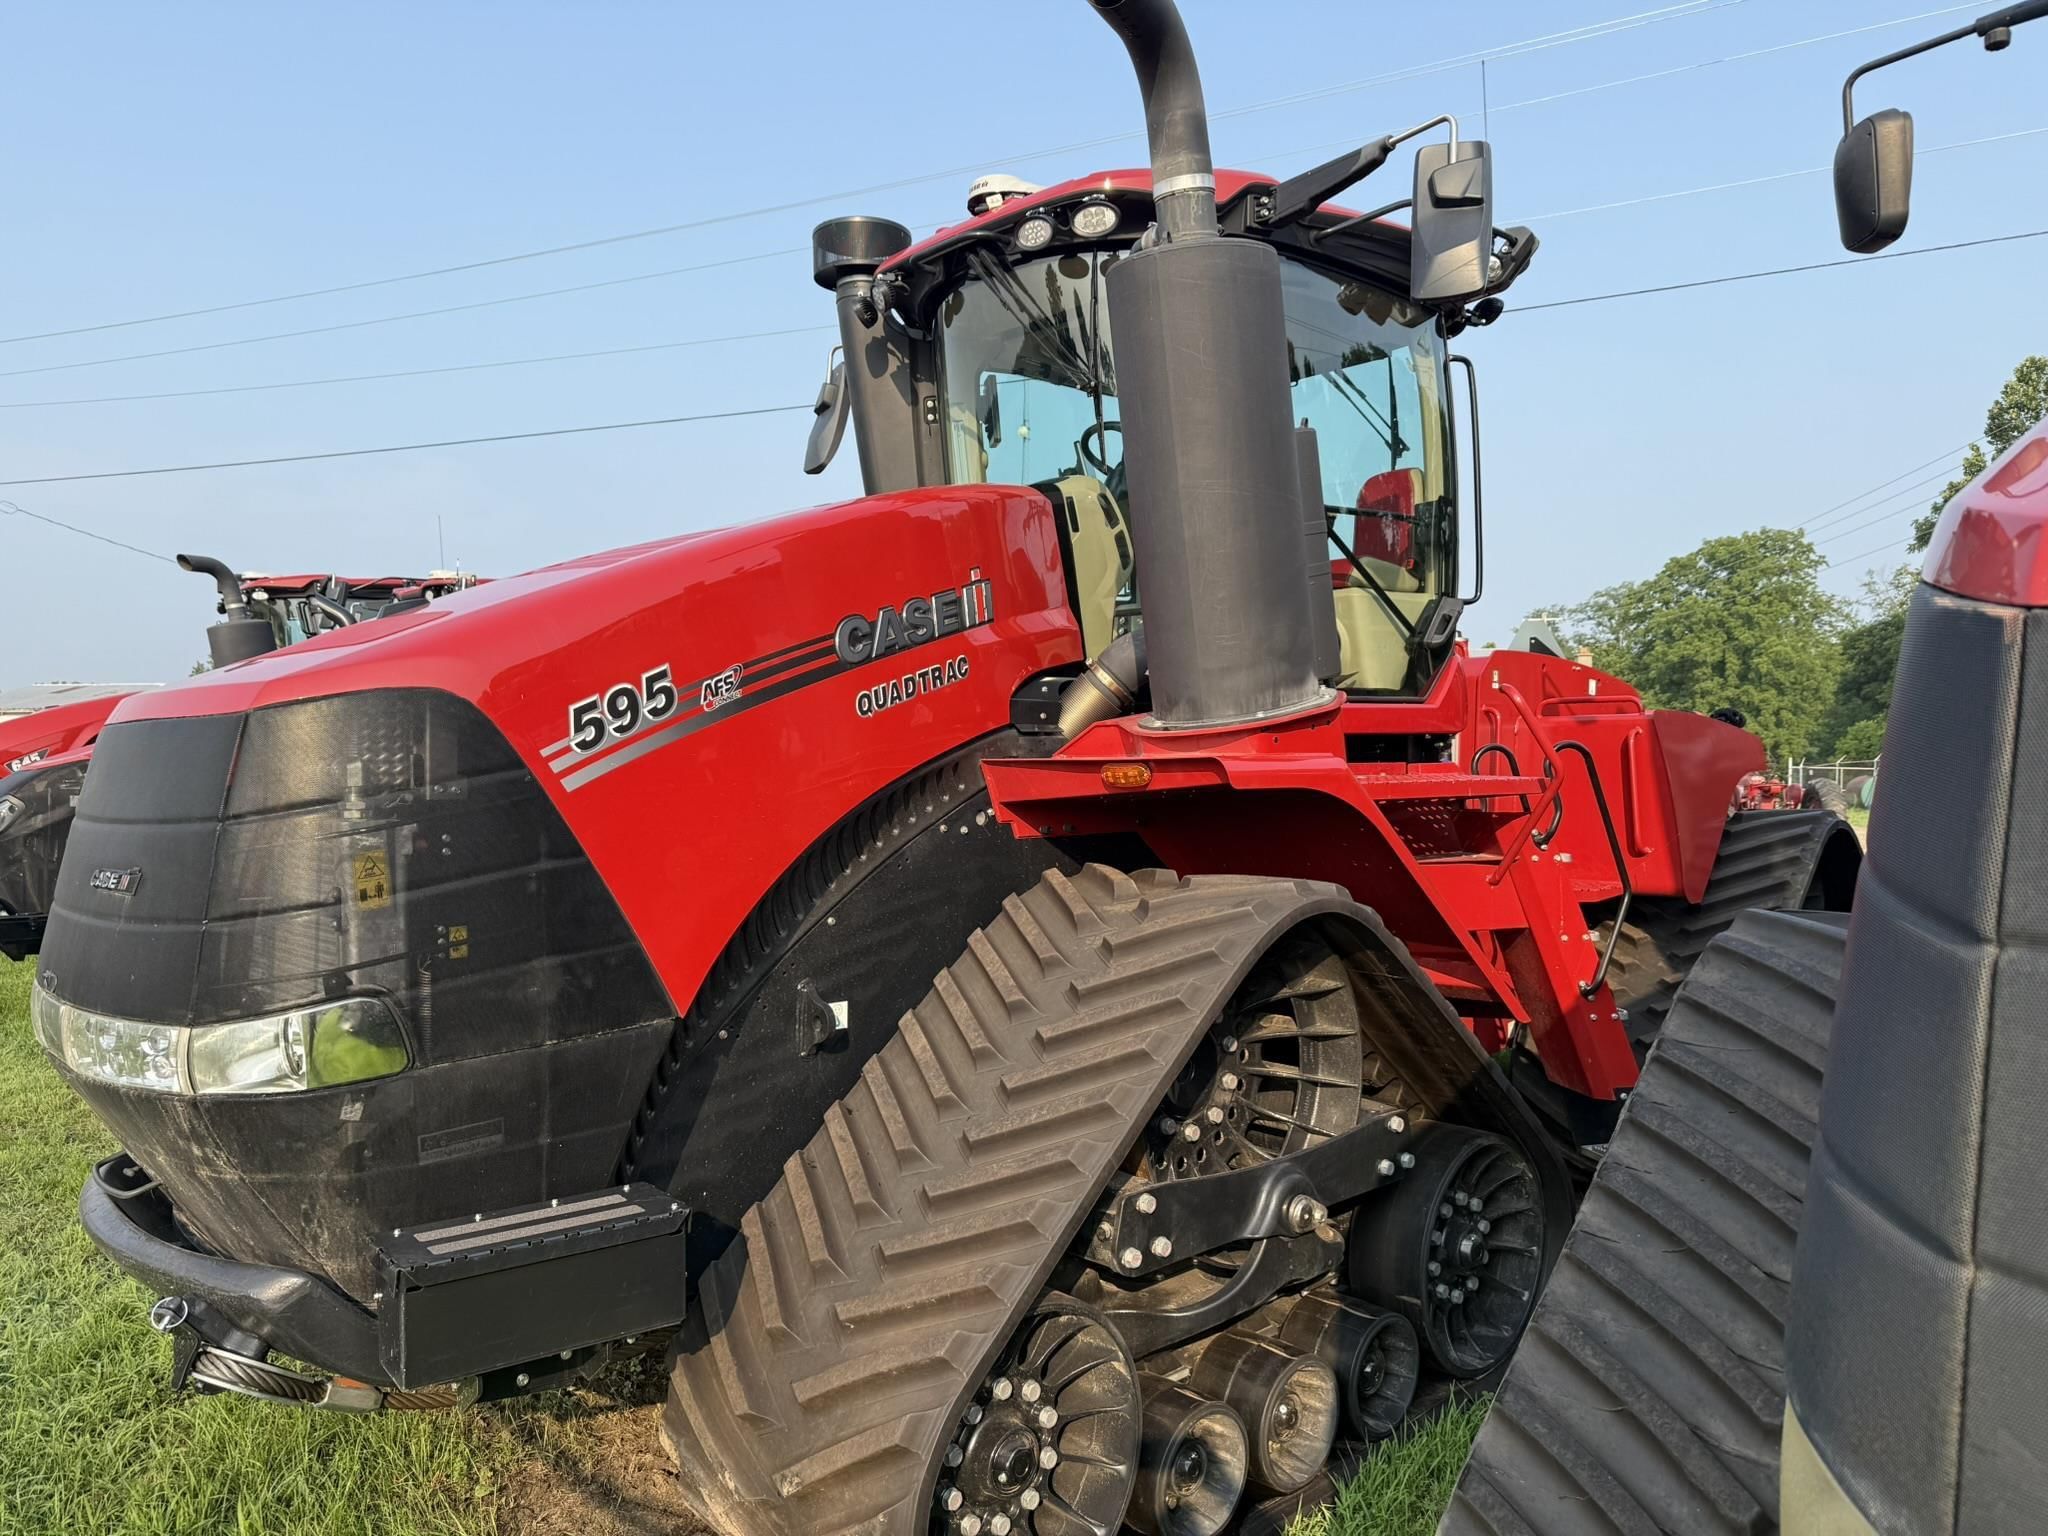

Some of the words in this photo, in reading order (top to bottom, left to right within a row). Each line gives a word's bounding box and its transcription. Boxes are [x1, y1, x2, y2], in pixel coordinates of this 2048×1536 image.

[568, 662, 678, 754] 595
[701, 670, 736, 705] AFS
[856, 655, 969, 717] QUADTRAC
[11, 752, 41, 772] 645
